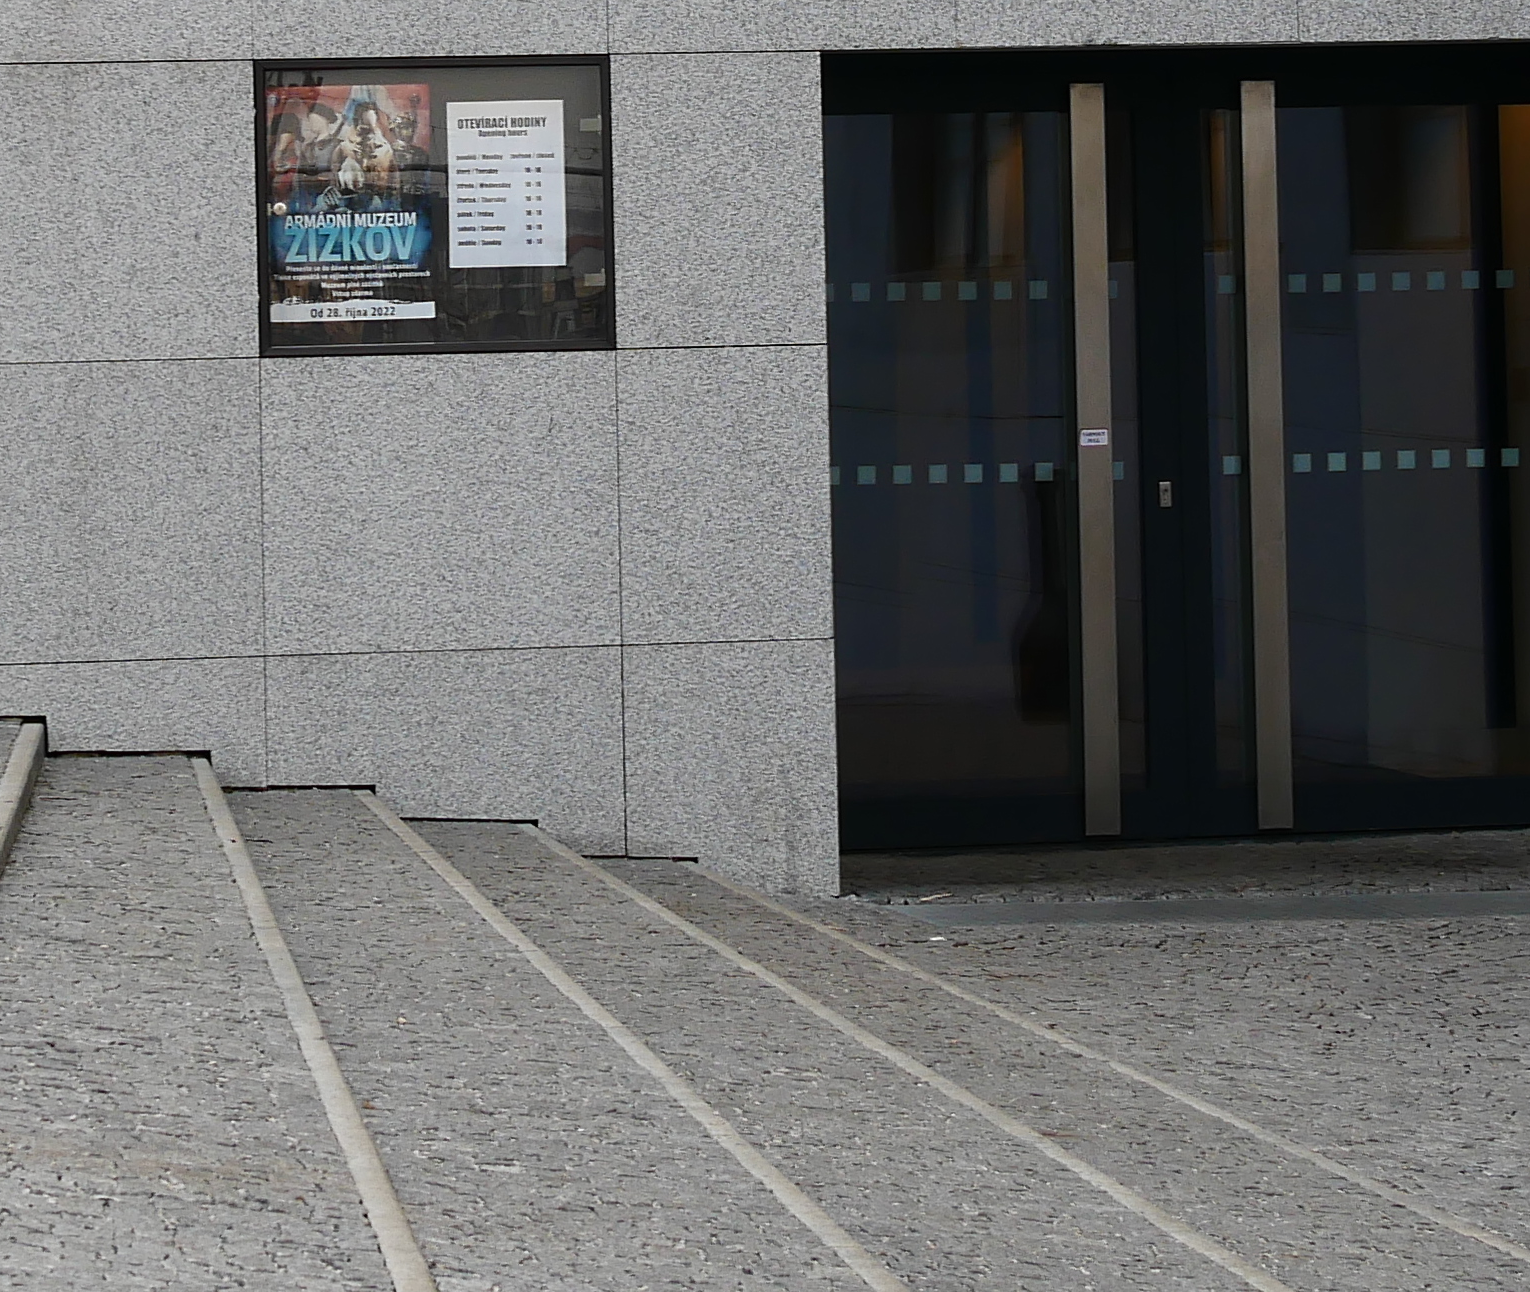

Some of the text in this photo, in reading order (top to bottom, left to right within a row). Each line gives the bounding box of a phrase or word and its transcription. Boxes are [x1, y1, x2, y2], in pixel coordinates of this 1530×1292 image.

[285, 211, 417, 229] ARMÁDNÍ MUZEUM
[310, 308, 324, 318] Od
[326, 308, 343, 318] 28.
[371, 307, 396, 317] 2022
